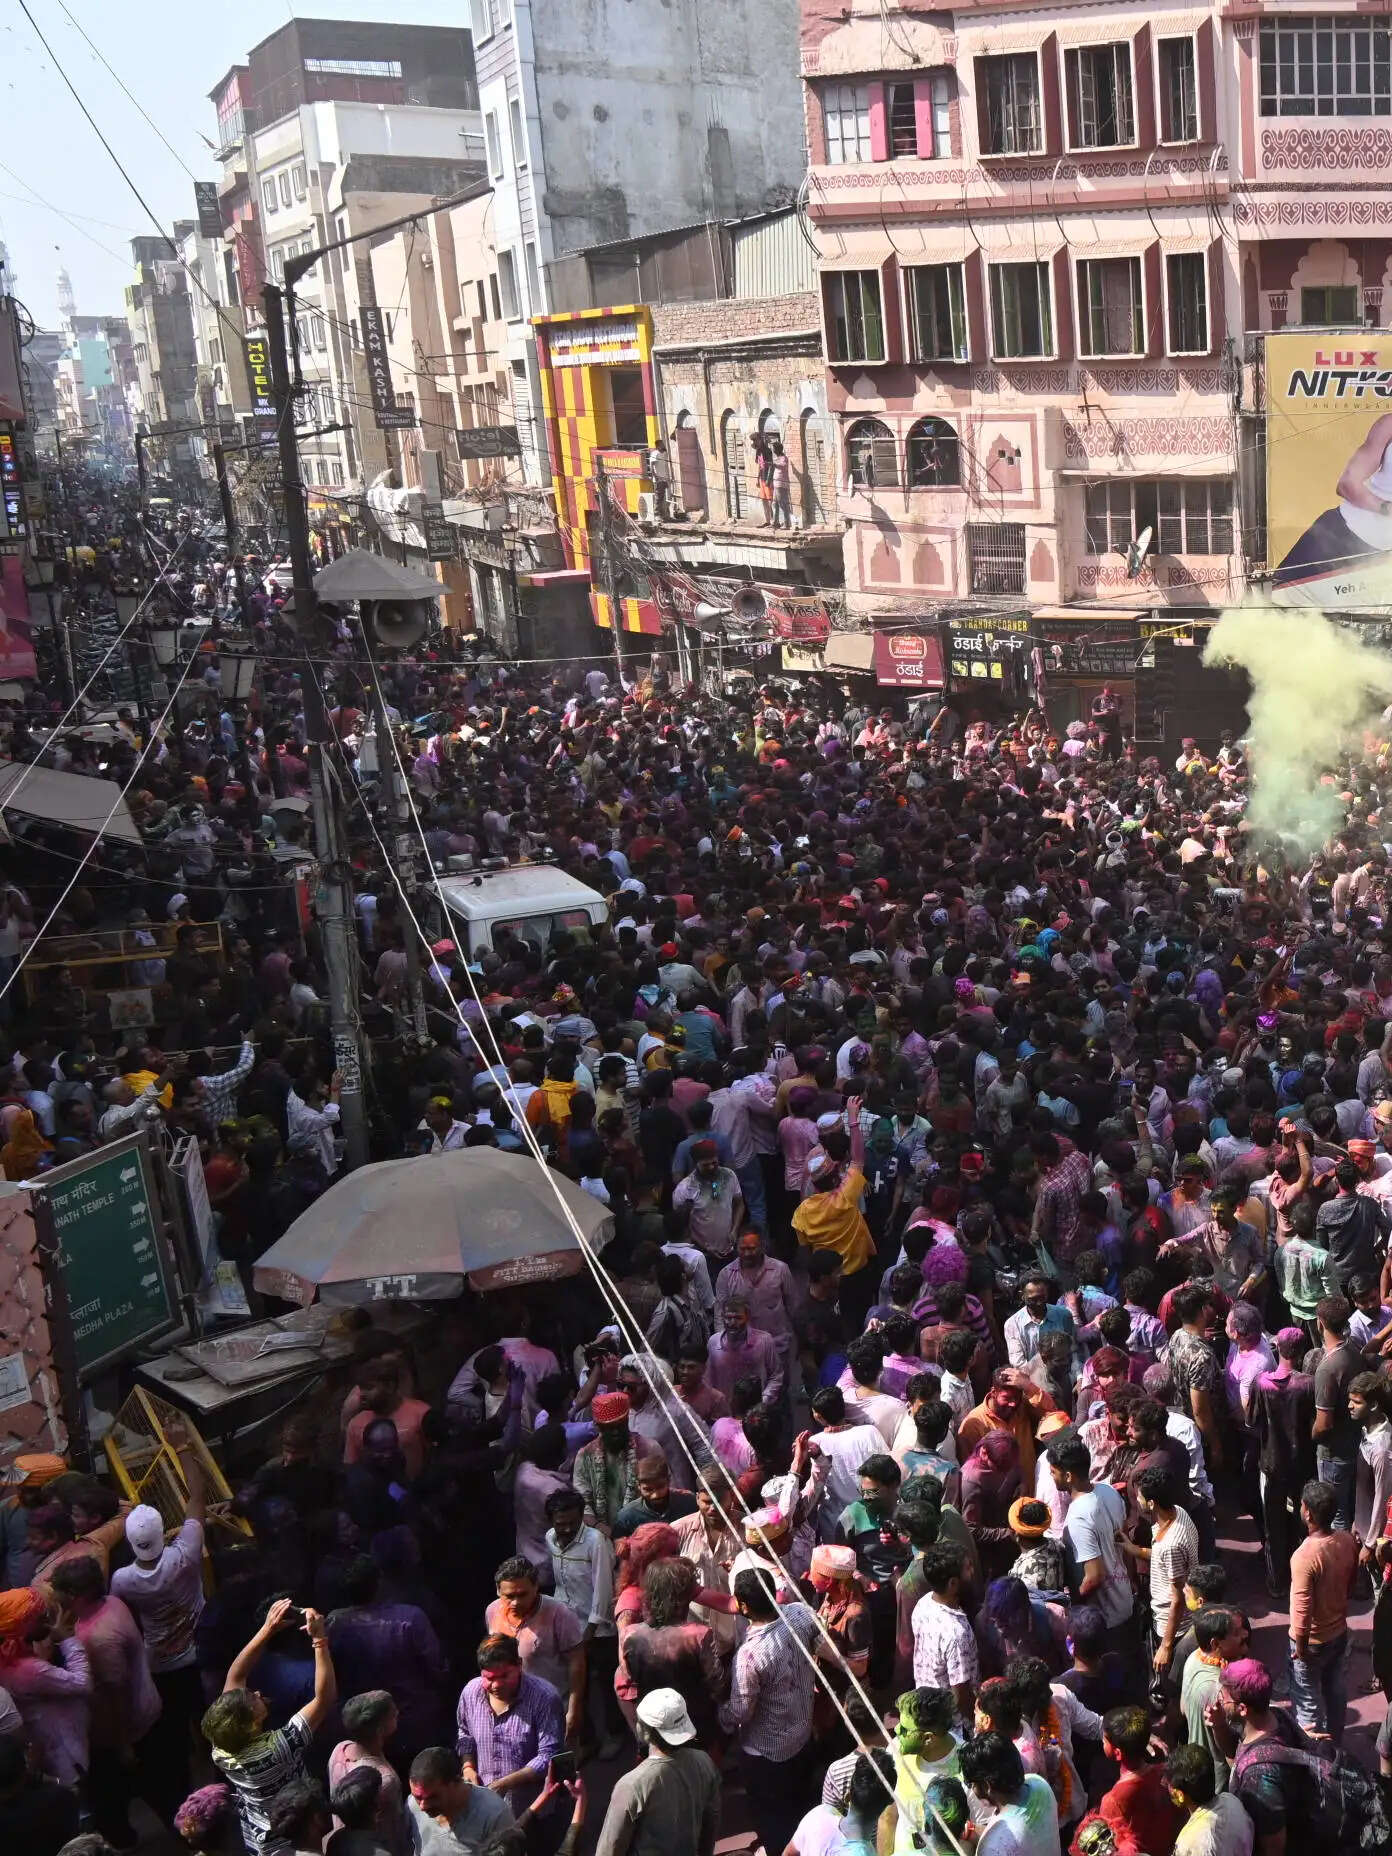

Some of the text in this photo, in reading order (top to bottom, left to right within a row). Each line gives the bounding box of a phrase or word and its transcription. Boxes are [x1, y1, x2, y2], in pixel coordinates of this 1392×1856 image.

[367, 311, 387, 408] EKAM KASHI
[1315, 351, 1378, 366] LUX
[248, 342, 269, 396] HOTEL
[1334, 584, 1356, 596] Yeh
[953, 632, 983, 652] ठंडाई
[896, 660, 925, 677] ठंडाई
[81, 1192, 115, 1216] TEMPLE
